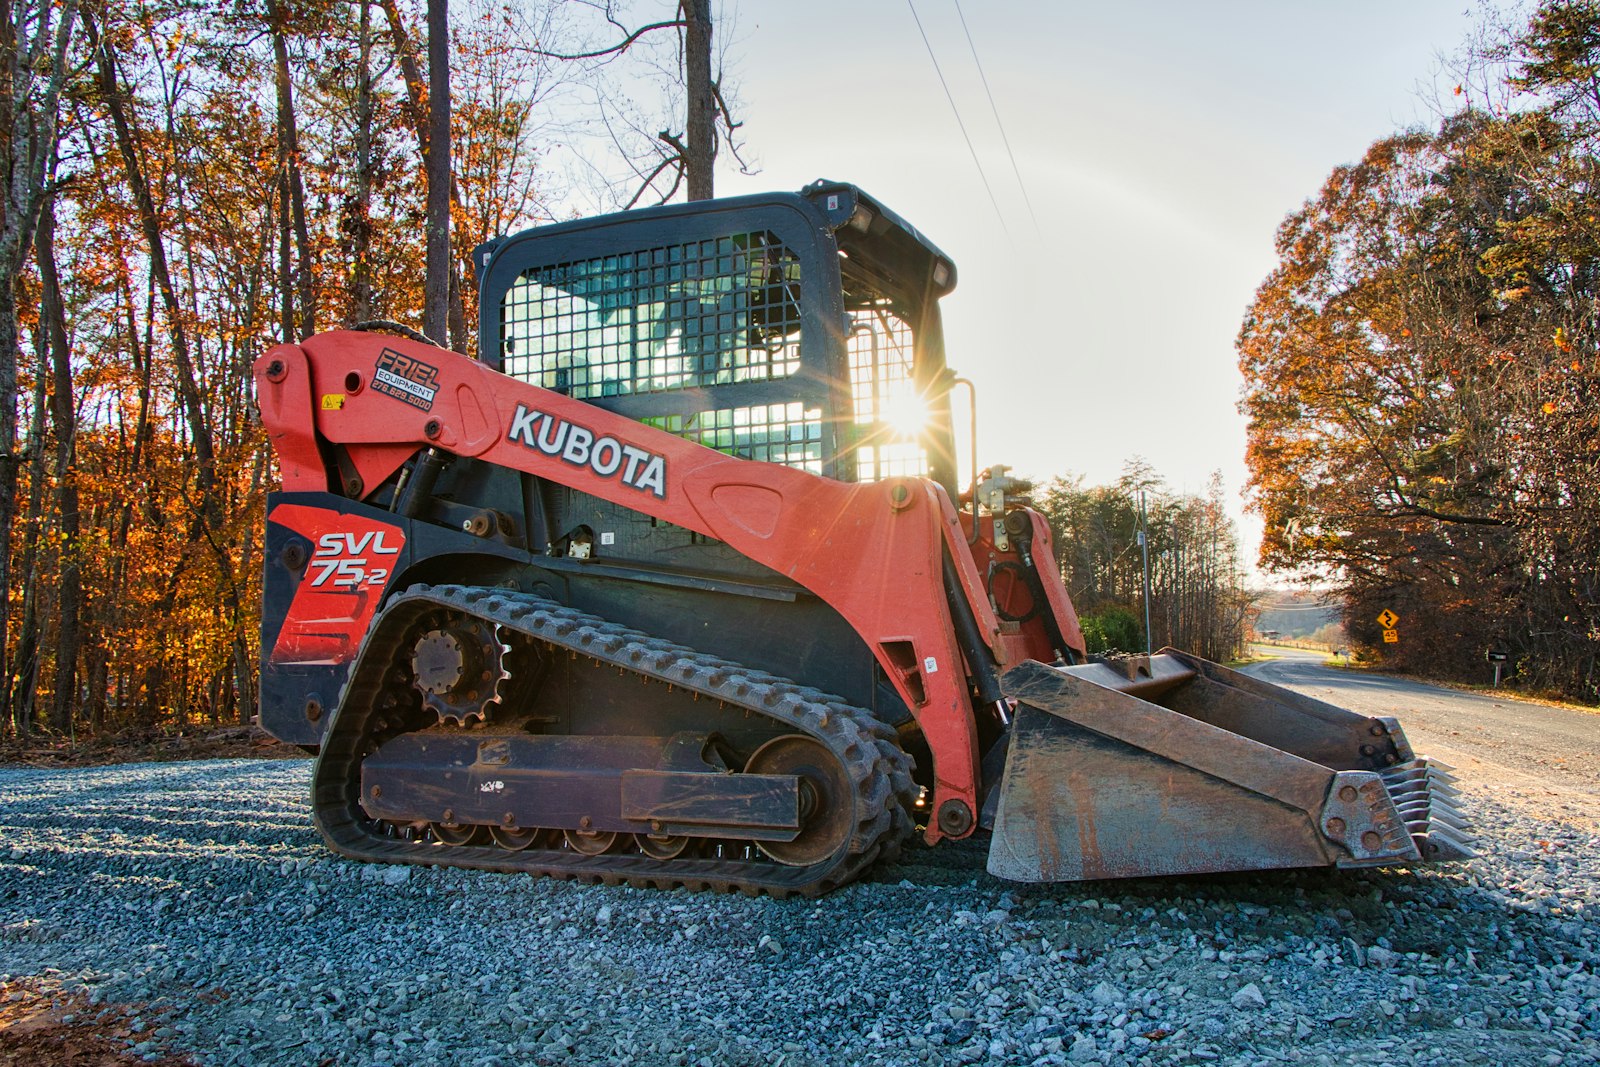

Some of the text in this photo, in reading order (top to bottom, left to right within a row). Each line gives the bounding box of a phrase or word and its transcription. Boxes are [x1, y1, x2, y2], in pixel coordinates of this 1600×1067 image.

[376, 349, 439, 391] FRIEL
[378, 370, 432, 398] EQUIPMENT
[371, 380, 432, 410] 276.629.5000
[508, 404, 665, 497] KUBOTA
[315, 531, 399, 556] SVL
[310, 559, 388, 587] 75-2
